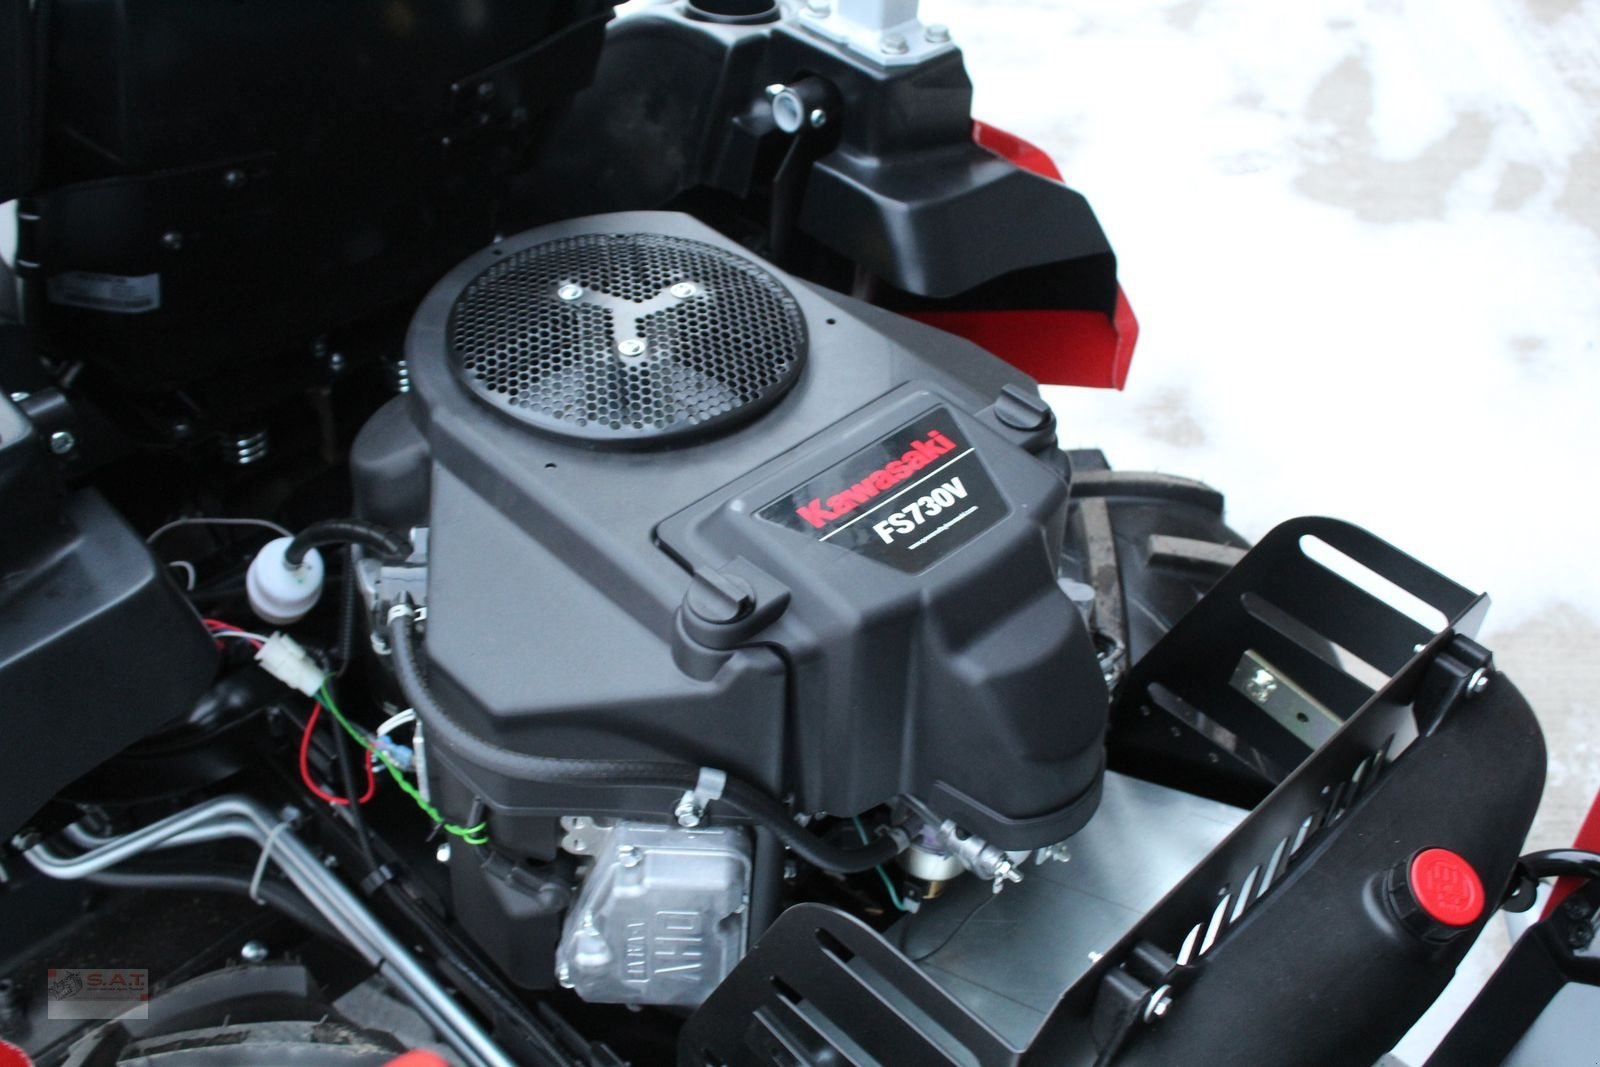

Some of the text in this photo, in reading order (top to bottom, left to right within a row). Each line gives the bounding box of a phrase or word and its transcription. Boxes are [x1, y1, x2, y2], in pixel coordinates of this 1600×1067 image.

[796, 429, 957, 529] Kawasaki
[872, 476, 968, 545] FS730V
[654, 910, 703, 981] OHV
